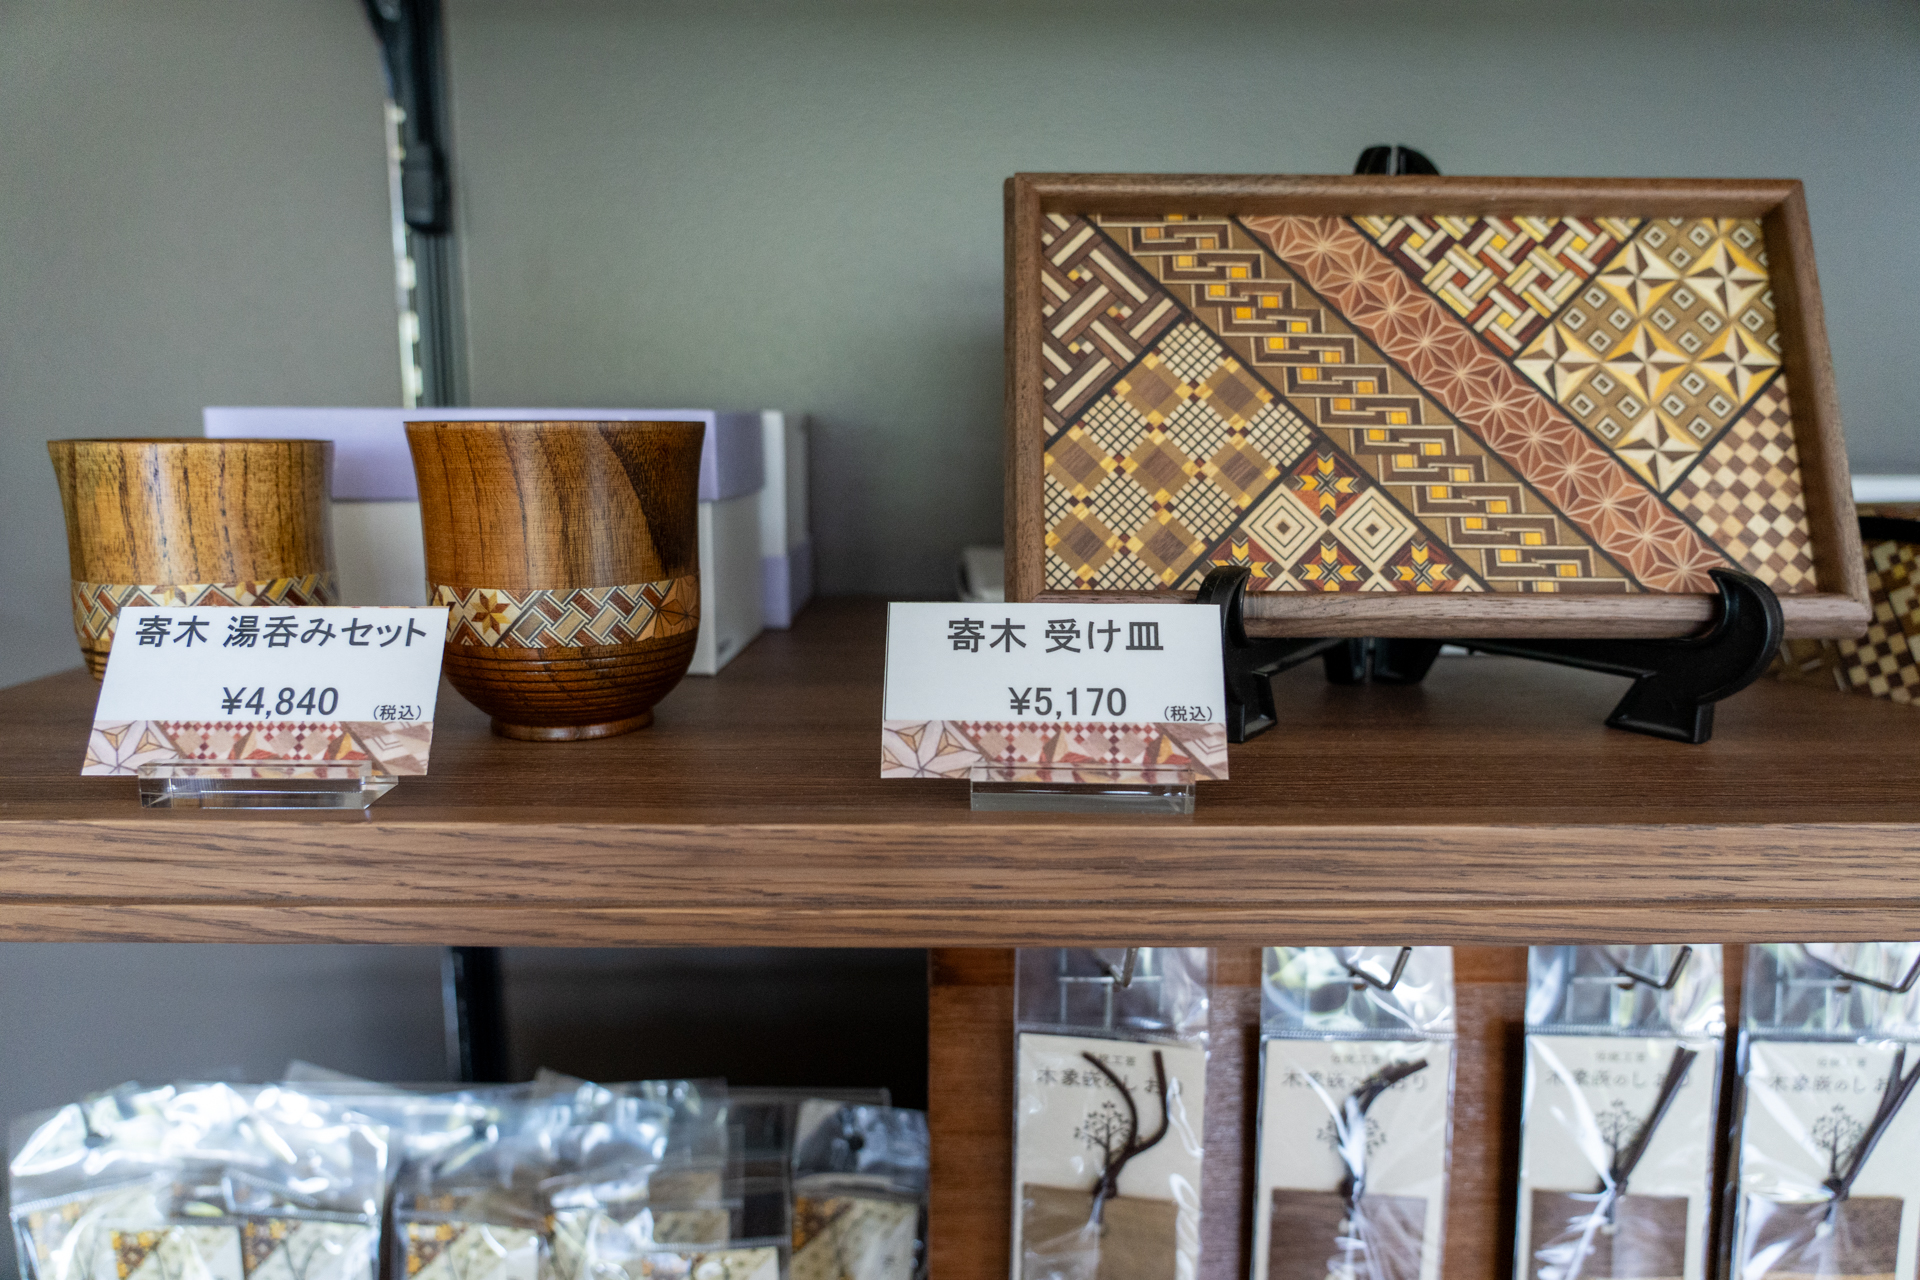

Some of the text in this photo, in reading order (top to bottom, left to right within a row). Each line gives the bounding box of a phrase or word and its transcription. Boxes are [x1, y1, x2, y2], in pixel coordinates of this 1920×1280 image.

[134, 614, 427, 649] 寄木 湯呑みセット
[947, 617, 1164, 653] 寄木 受け皿
[221, 686, 339, 719] ¥4,840
[1008, 686, 1127, 720] ¥5,170
